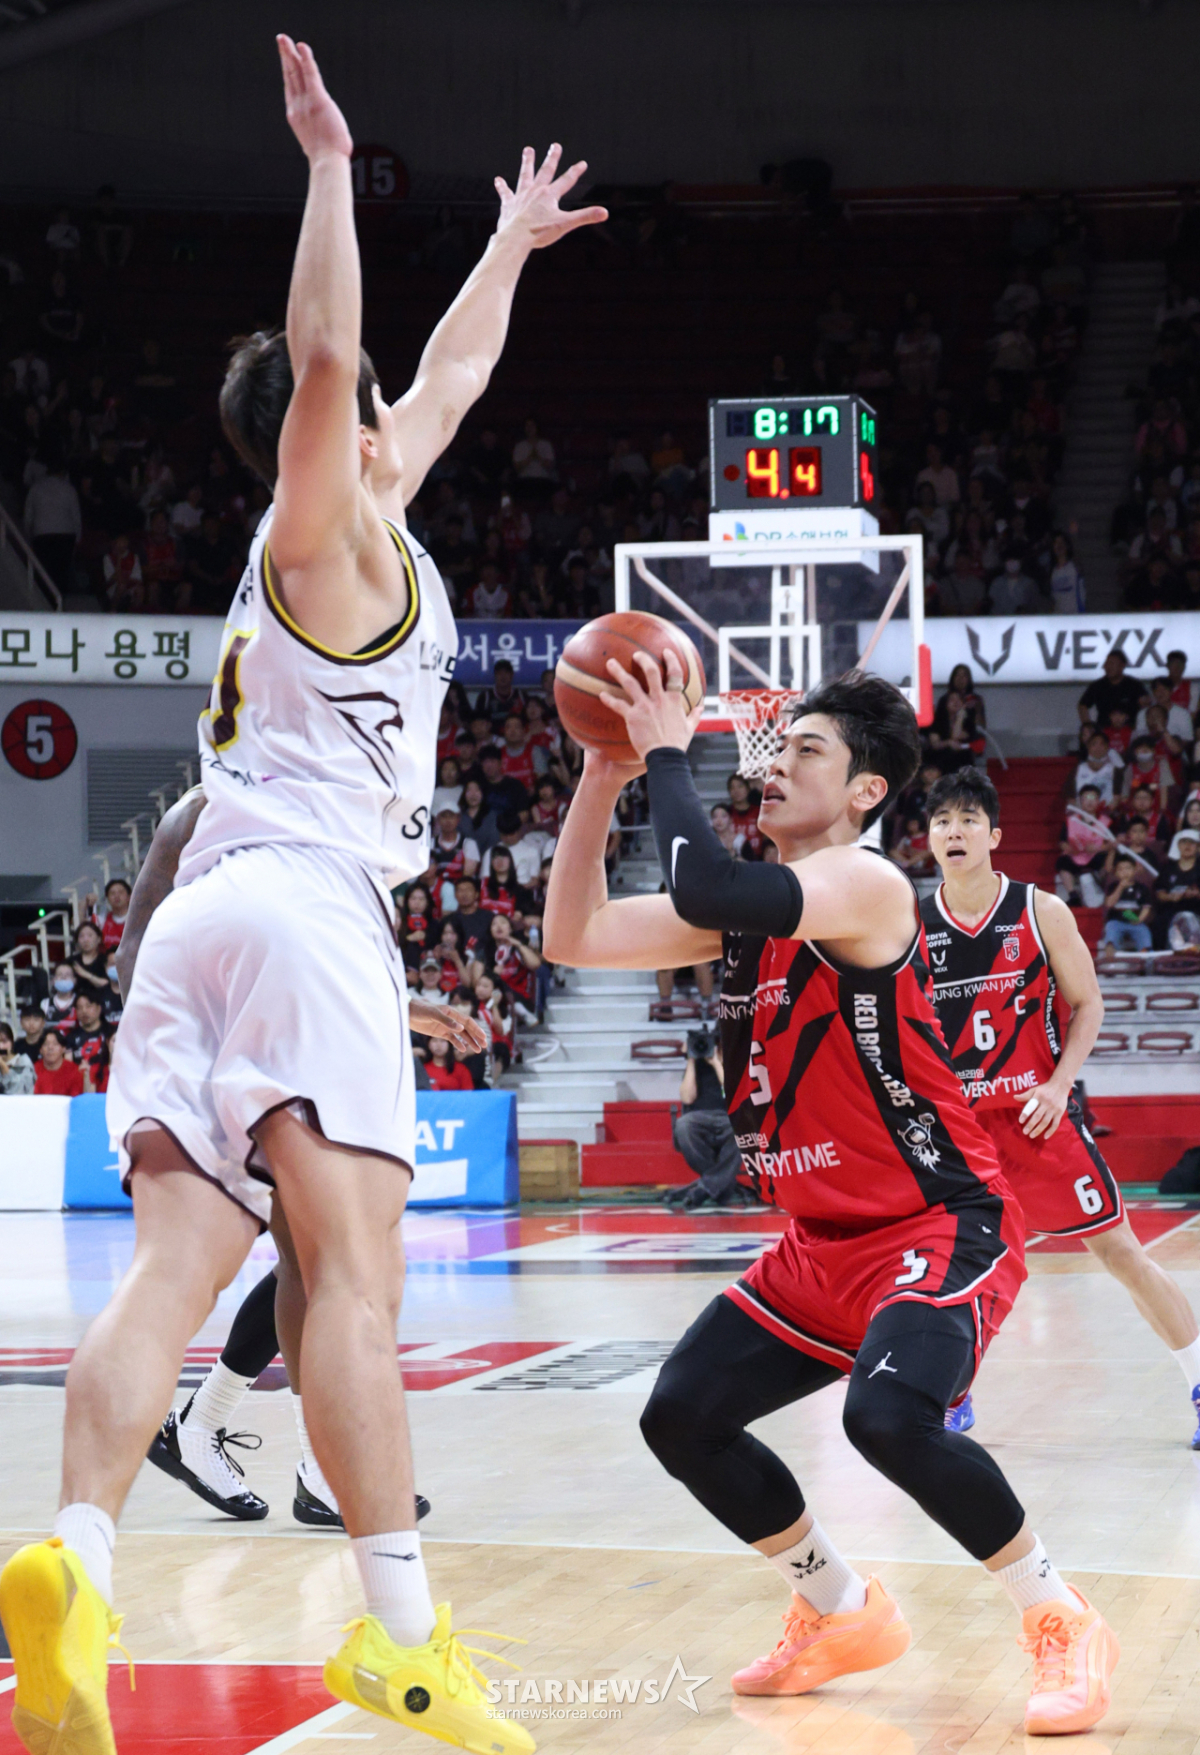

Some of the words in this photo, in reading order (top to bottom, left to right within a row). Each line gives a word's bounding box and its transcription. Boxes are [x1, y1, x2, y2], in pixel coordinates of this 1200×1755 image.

[352, 156, 396, 195] 15
[754, 405, 839, 440] 8:17
[105, 629, 190, 680] 용평
[26, 715, 54, 764] 5
[932, 987, 961, 1004] JUNG
[964, 981, 998, 998] KWAN
[1000, 976, 1025, 994] JANG
[1014, 995, 1026, 1015] C
[854, 993, 879, 1030] RED
[973, 1009, 996, 1051] 6
[748, 1040, 773, 1106] 5
[1074, 1174, 1103, 1216] 6
[895, 1249, 929, 1286] 5
